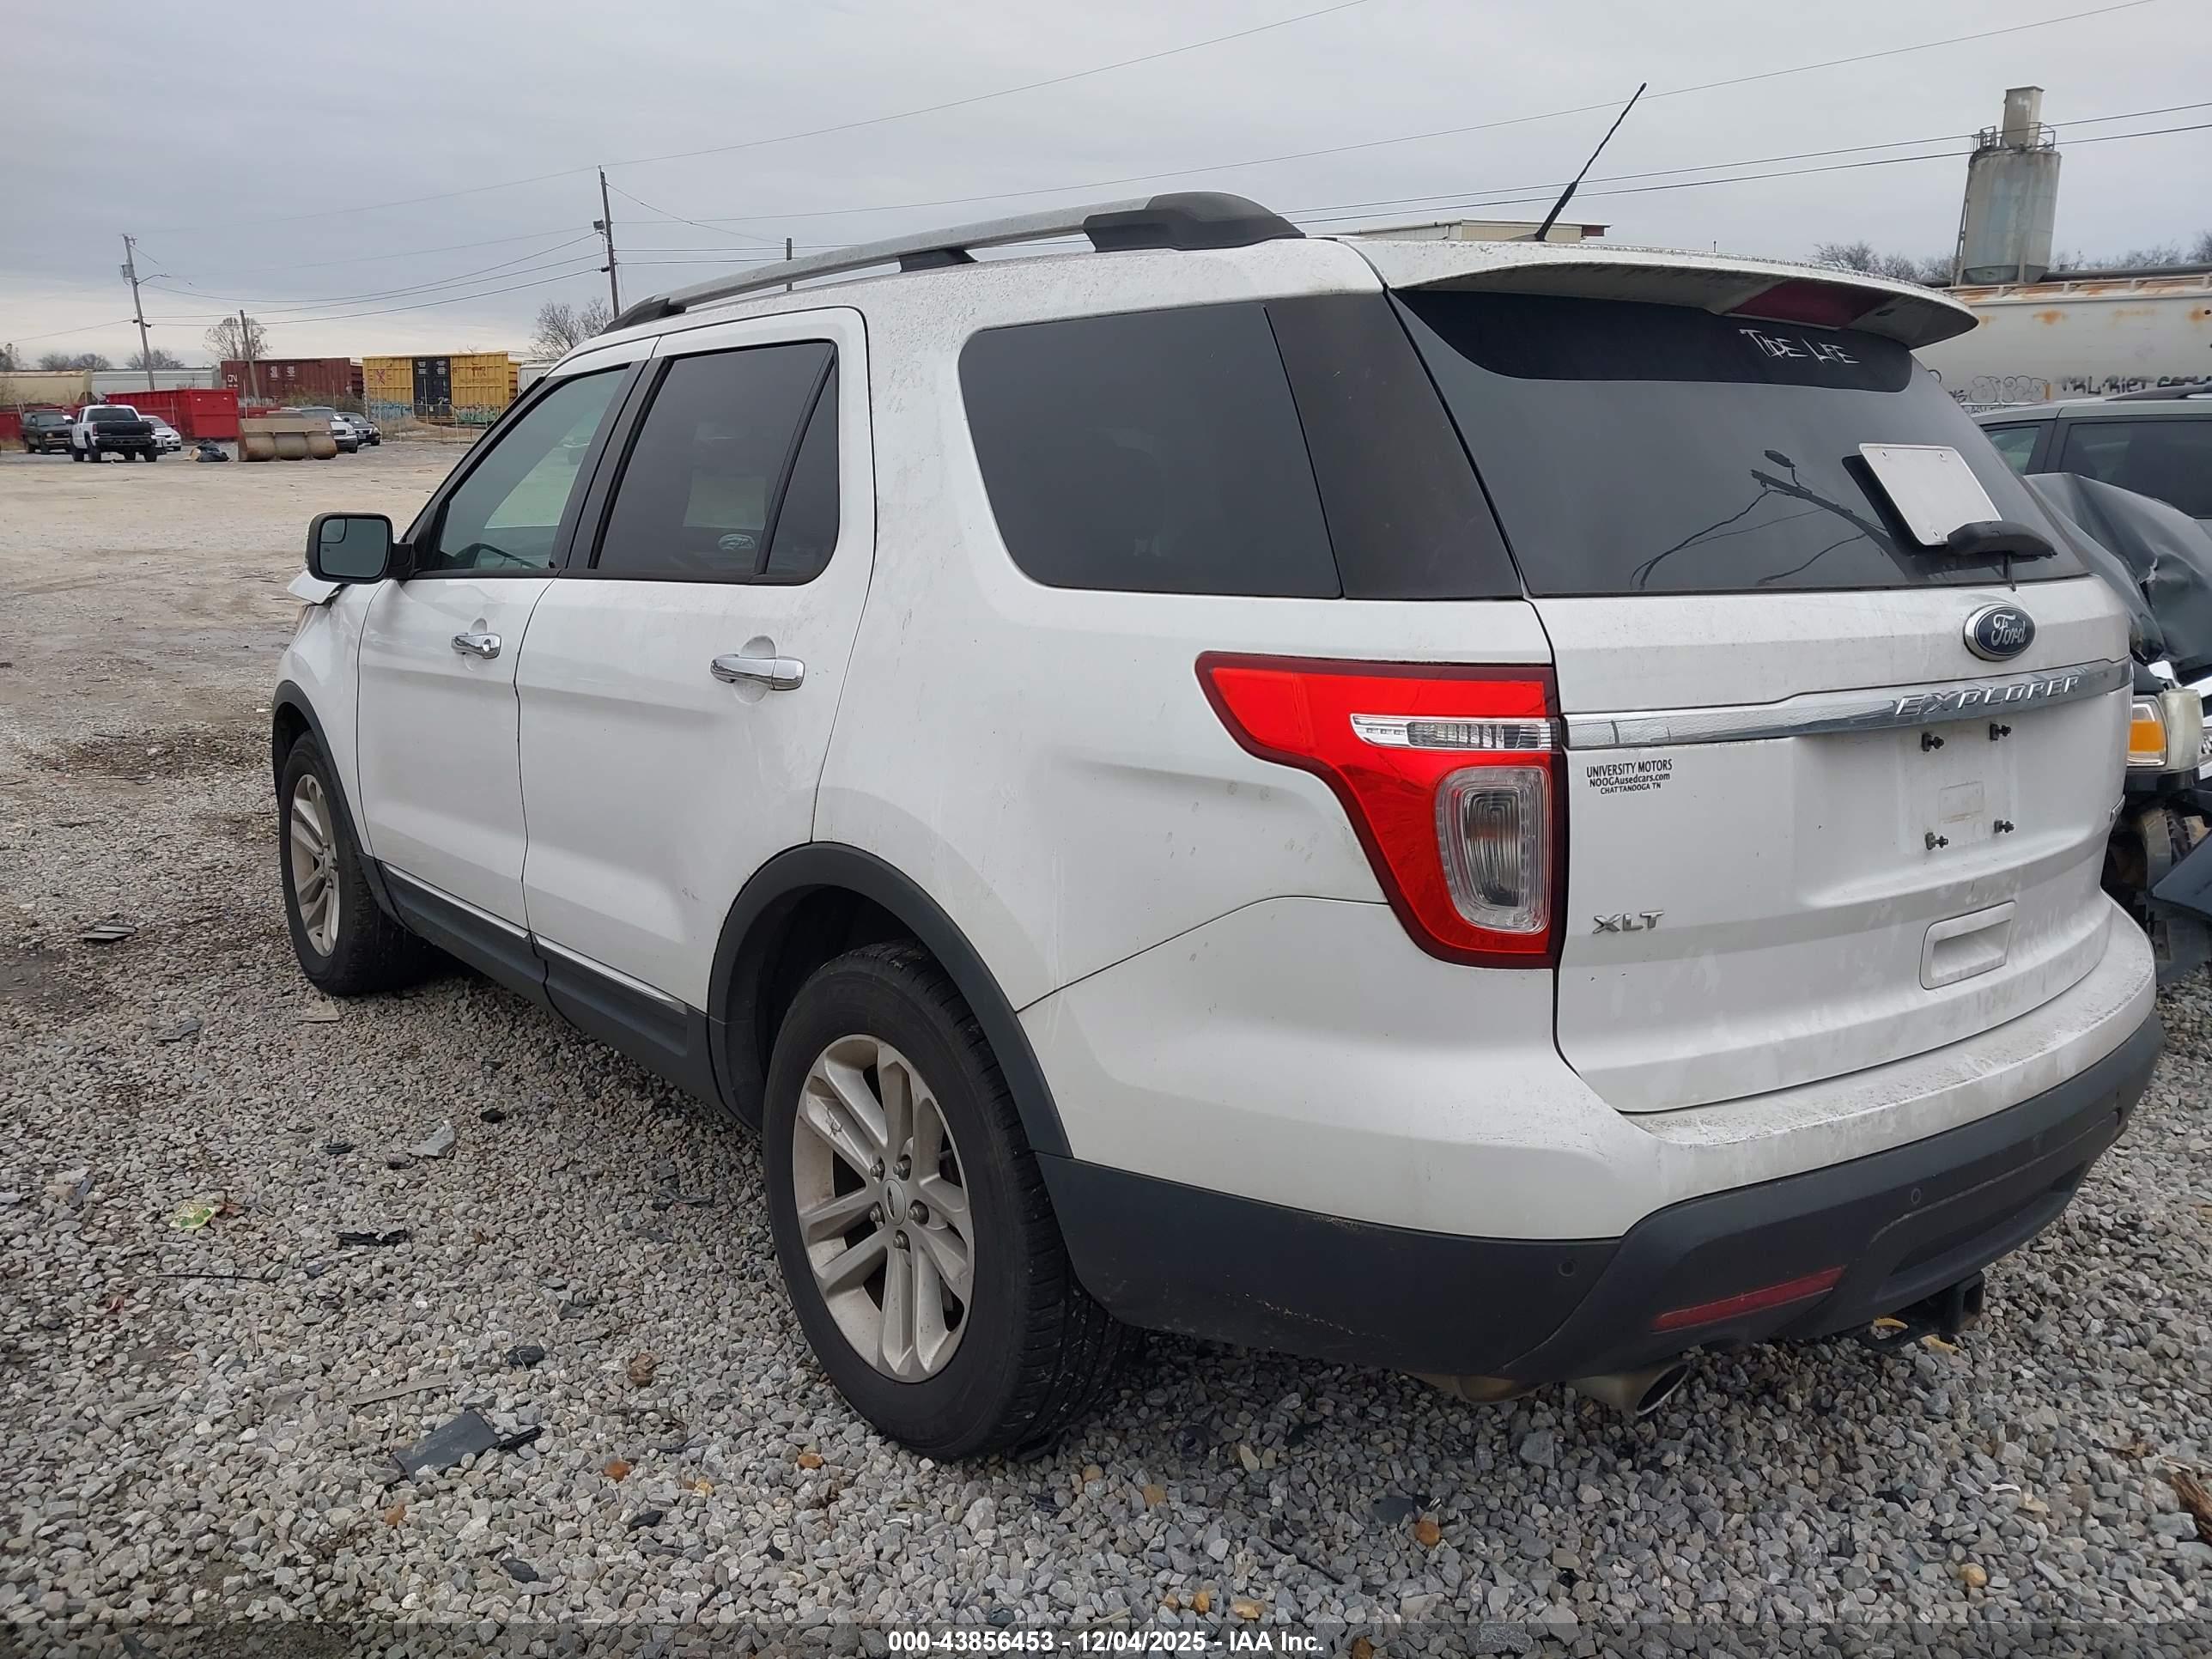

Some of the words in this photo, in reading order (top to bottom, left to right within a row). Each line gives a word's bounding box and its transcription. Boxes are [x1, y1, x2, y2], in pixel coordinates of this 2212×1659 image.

[1990, 613, 2027, 646] Ford
[1895, 674, 2081, 716] EXPLORER
[1586, 763, 1637, 778] UNIVERSITY
[1638, 759, 1673, 773] MOTORS
[1589, 773, 1670, 787] NOOGAusedcars.com
[1600, 783, 1650, 795] CHATTANOOGA
[1592, 910, 1664, 934] XLT
